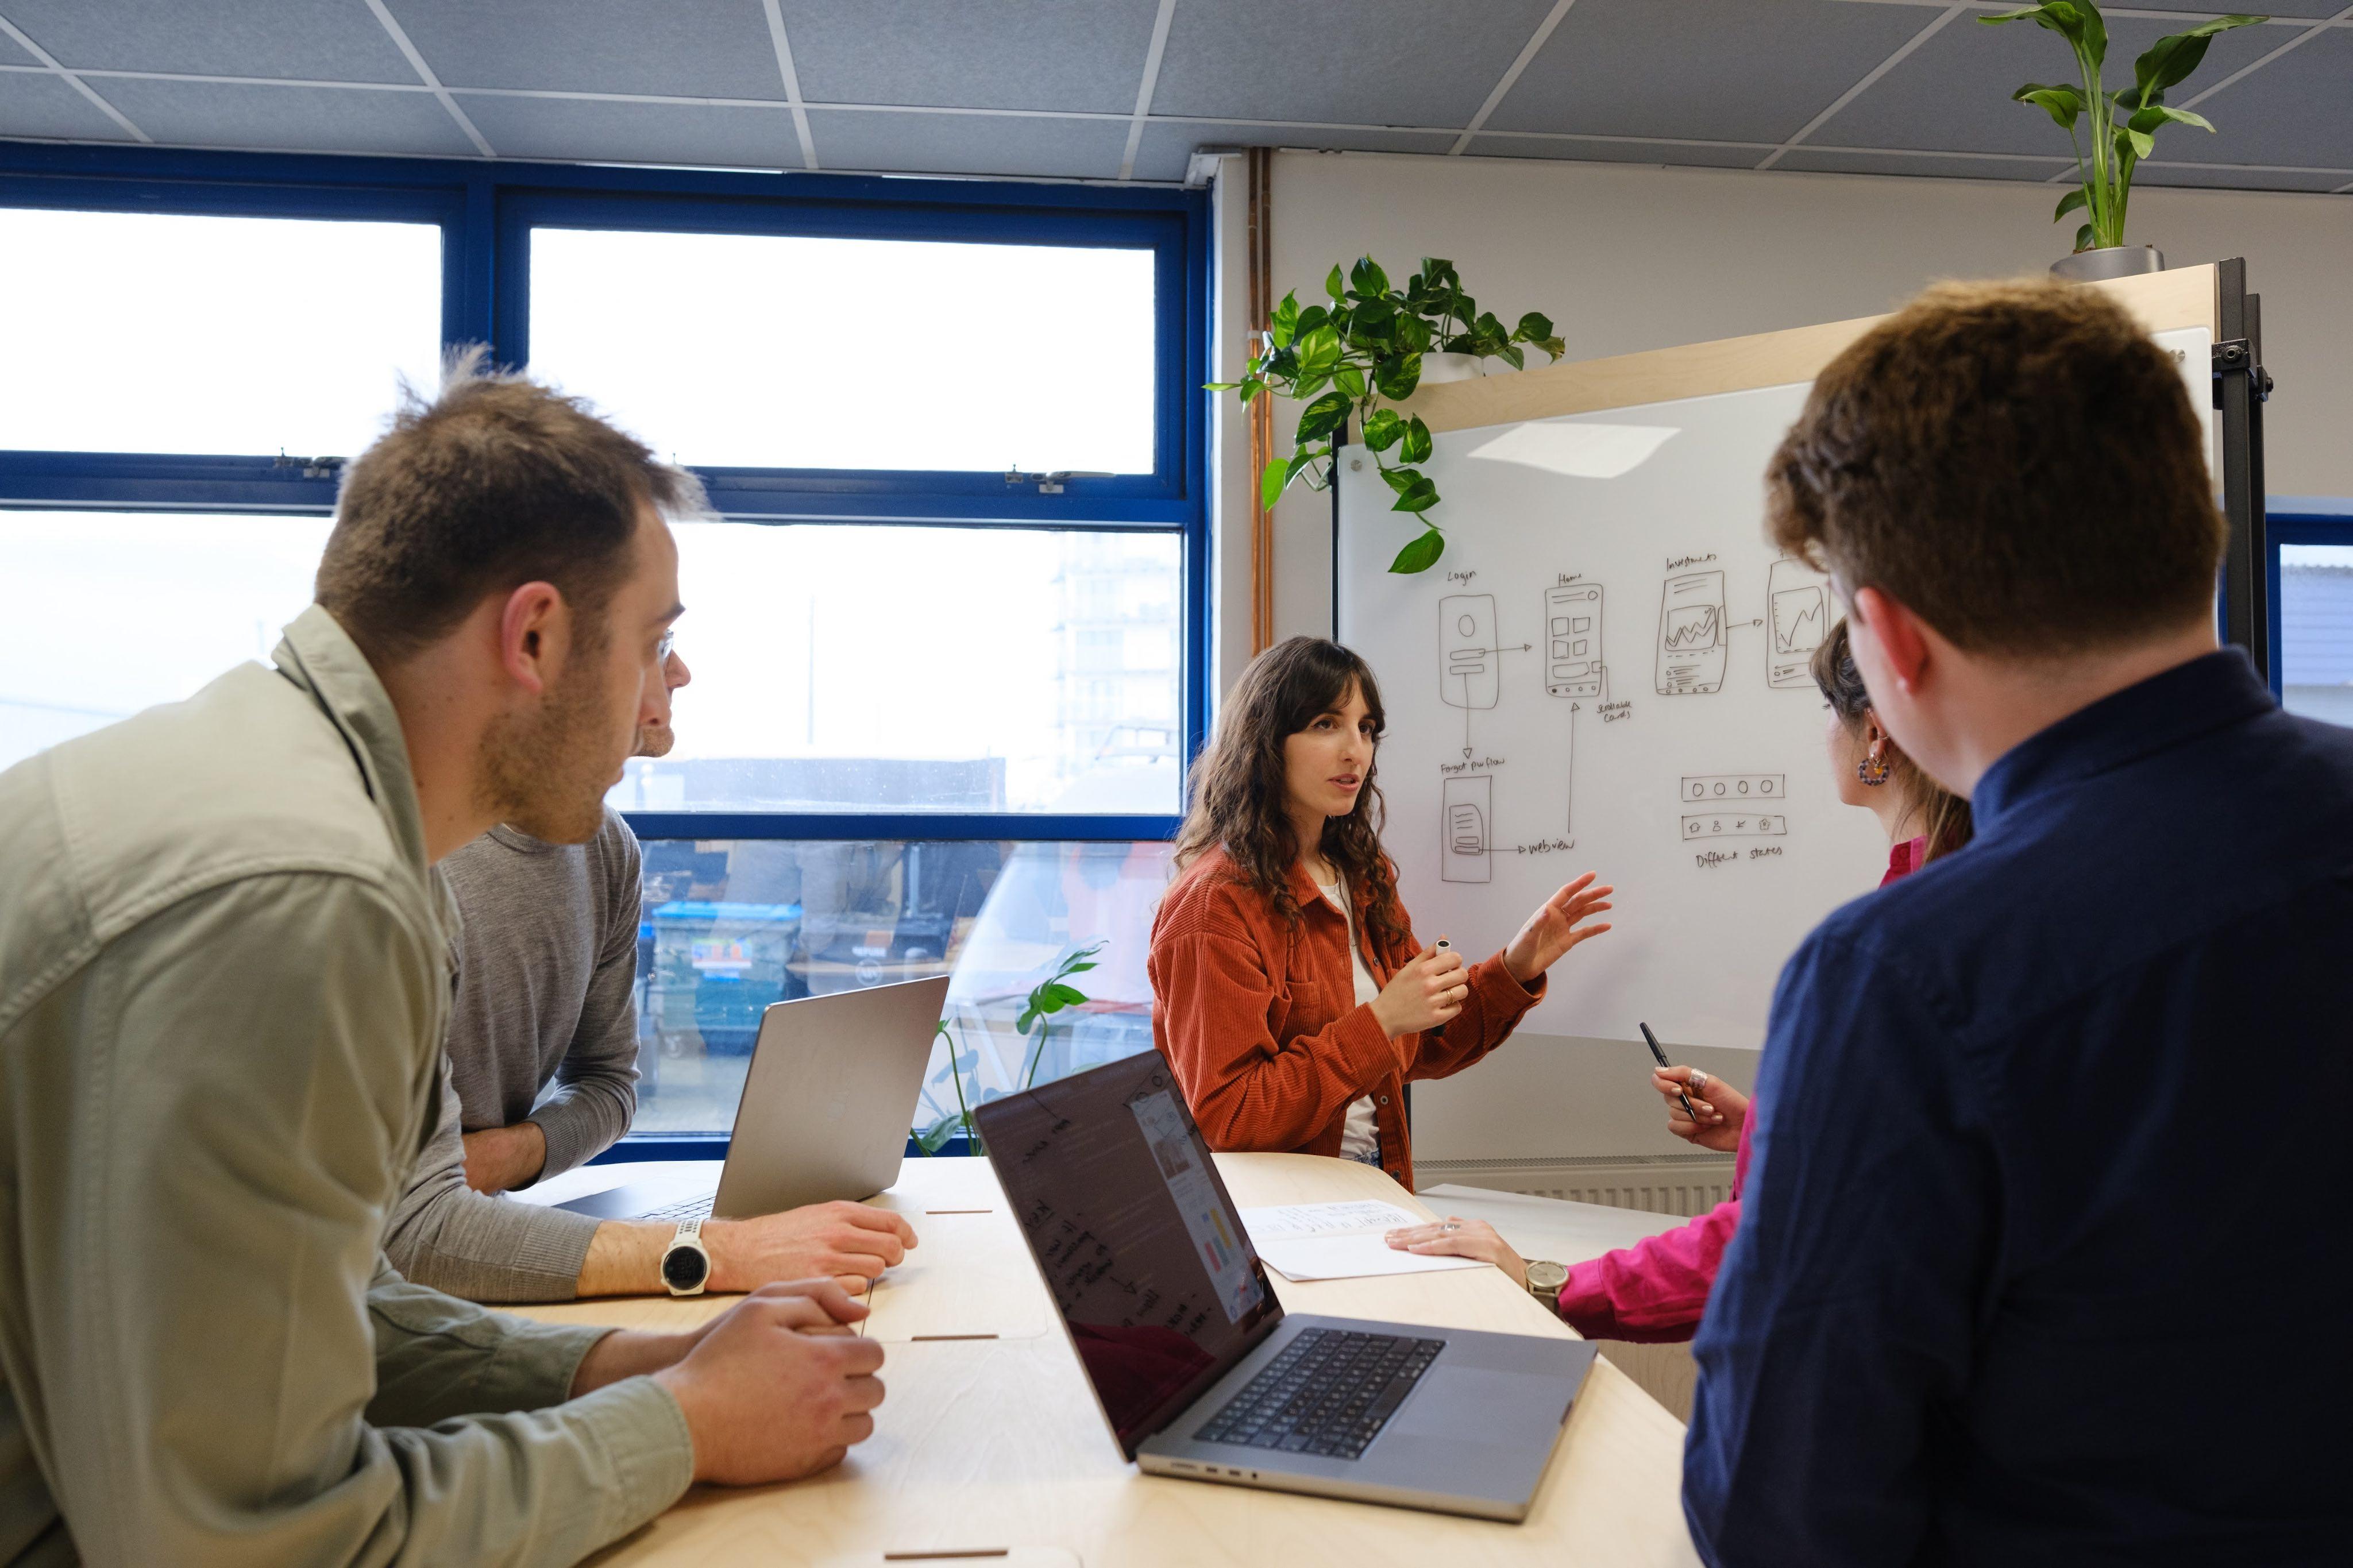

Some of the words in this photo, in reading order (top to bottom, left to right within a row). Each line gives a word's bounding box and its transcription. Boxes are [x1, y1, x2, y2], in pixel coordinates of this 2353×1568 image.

[1448, 571, 1476, 586] Login
[1441, 762, 1467, 774] Forgot
[1486, 757, 1505, 769] flow
[1749, 846, 1783, 859] states
